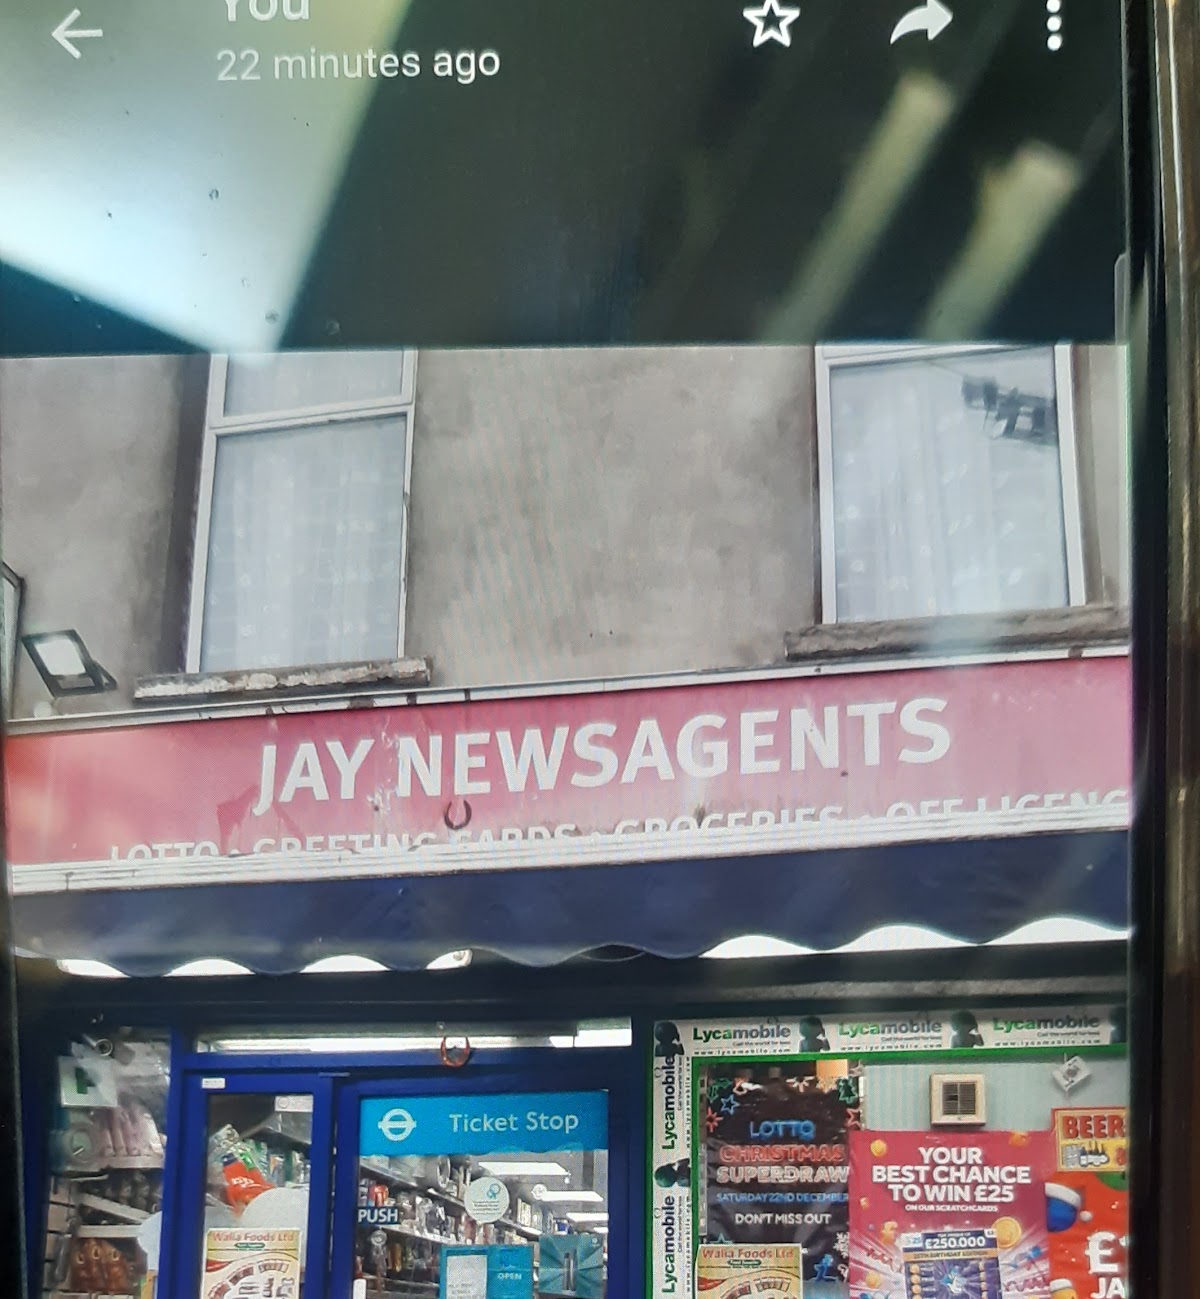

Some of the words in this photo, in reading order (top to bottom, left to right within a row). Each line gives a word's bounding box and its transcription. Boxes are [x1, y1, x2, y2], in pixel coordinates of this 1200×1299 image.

[216, 48, 261, 81] 22
[273, 46, 421, 79] minutes
[432, 49, 501, 85] ago
[253, 738, 376, 816] JAY
[397, 697, 952, 798] NEWSAGENTS
[838, 1019, 942, 1038] Lycamobile
[993, 1015, 1100, 1033] Lycamobile
[693, 1025, 791, 1043] Lycamobile
[662, 1056, 677, 1150] Lycamobile
[449, 1112, 519, 1133] Ticket
[525, 1111, 580, 1134] Stop
[749, 1120, 816, 1138] LOTTO
[719, 1144, 845, 1162] CHRISTMAS
[918, 1146, 983, 1165] YOUR
[716, 1165, 849, 1184] SUPERDRAW
[872, 1165, 930, 1183] BEST
[932, 1165, 1031, 1184] CHANCE
[716, 1193, 767, 1202] SATURDAY
[887, 1184, 921, 1202] TO
[924, 1184, 971, 1202] WIN
[974, 1184, 1014, 1202] £25
[357, 1208, 398, 1223] PUSH
[935, 1204, 998, 1212] SCRATCHCARDS
[735, 1213, 773, 1225] DON'T
[774, 1213, 803, 1224] MISS
[804, 1213, 832, 1224] OUT
[662, 1195, 677, 1293] Lycamobile
[738, 1248, 773, 1259] Foods
[775, 1248, 794, 1258] Ltd
[497, 1272, 522, 1280] OPEN
